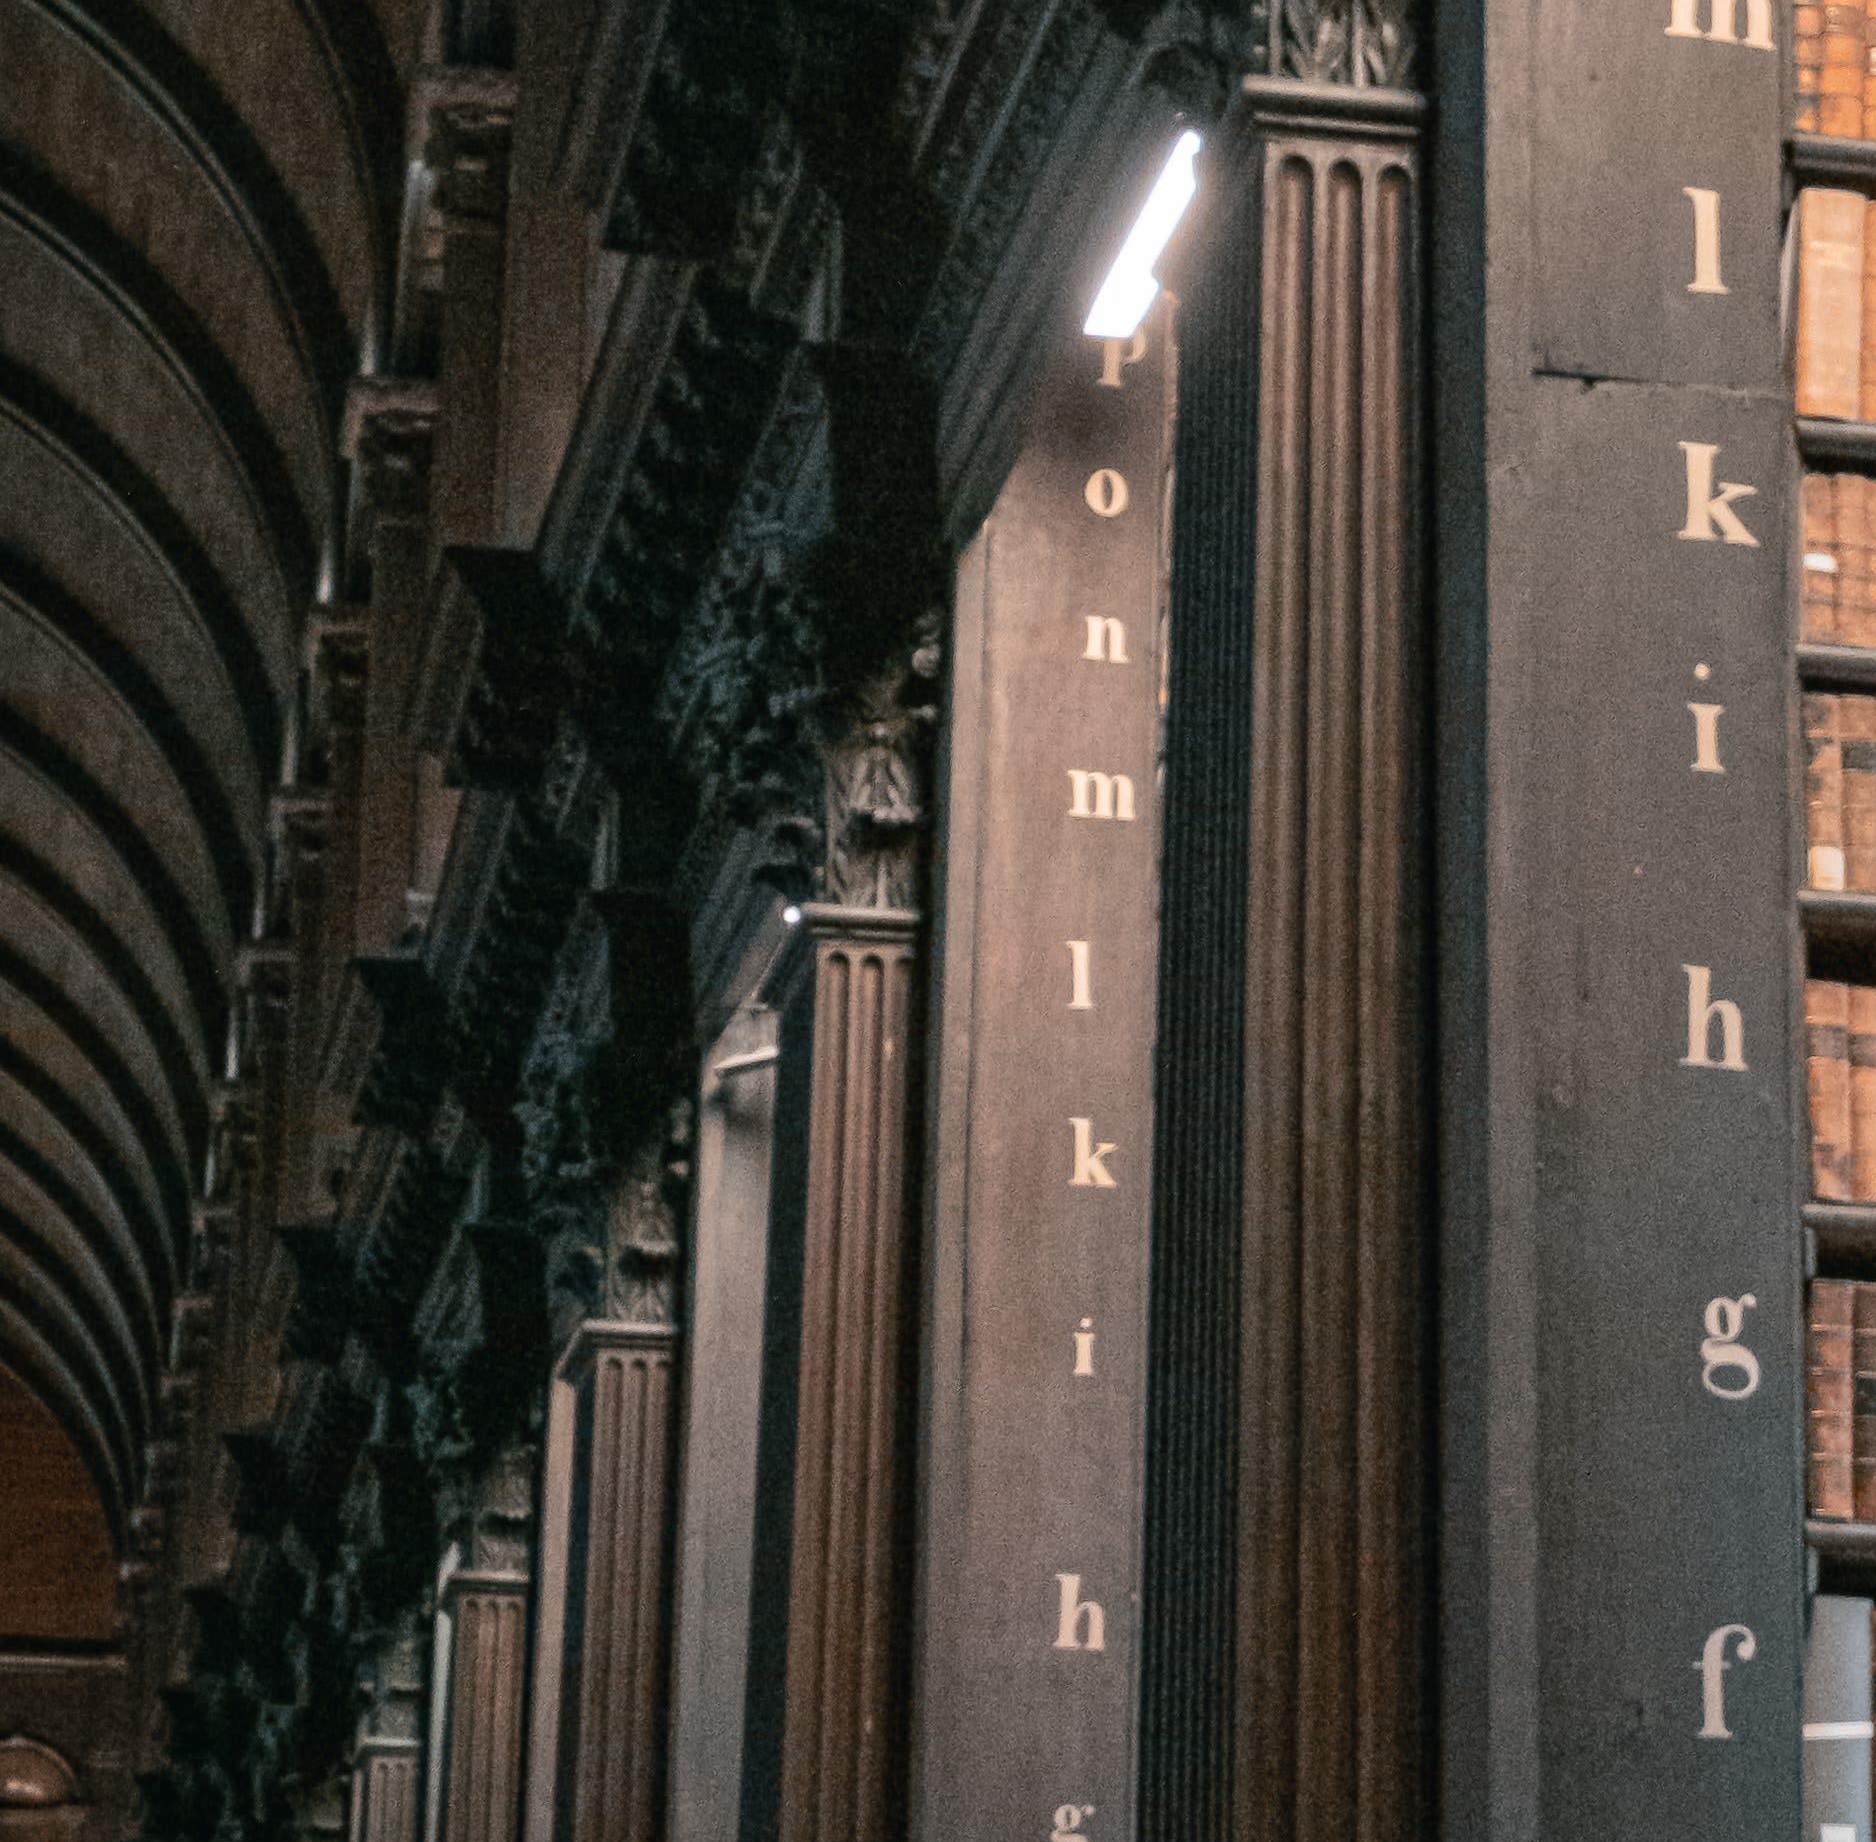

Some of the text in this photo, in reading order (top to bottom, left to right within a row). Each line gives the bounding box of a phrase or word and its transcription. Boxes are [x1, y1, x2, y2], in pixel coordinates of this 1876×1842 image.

[1683, 186, 1727, 294] l
[1085, 470, 1129, 517] o
[1678, 440, 1758, 546] k
[1083, 615, 1128, 663] n
[1687, 663, 1725, 773] i
[1068, 769, 1134, 820] m
[1067, 940, 1093, 1009] l
[1681, 964, 1748, 1071] h
[1070, 1116, 1116, 1187] k
[1073, 1317, 1095, 1376] i
[1701, 1293, 1761, 1400] g
[1054, 1572, 1105, 1651] h
[1694, 1623, 1757, 1739] f
